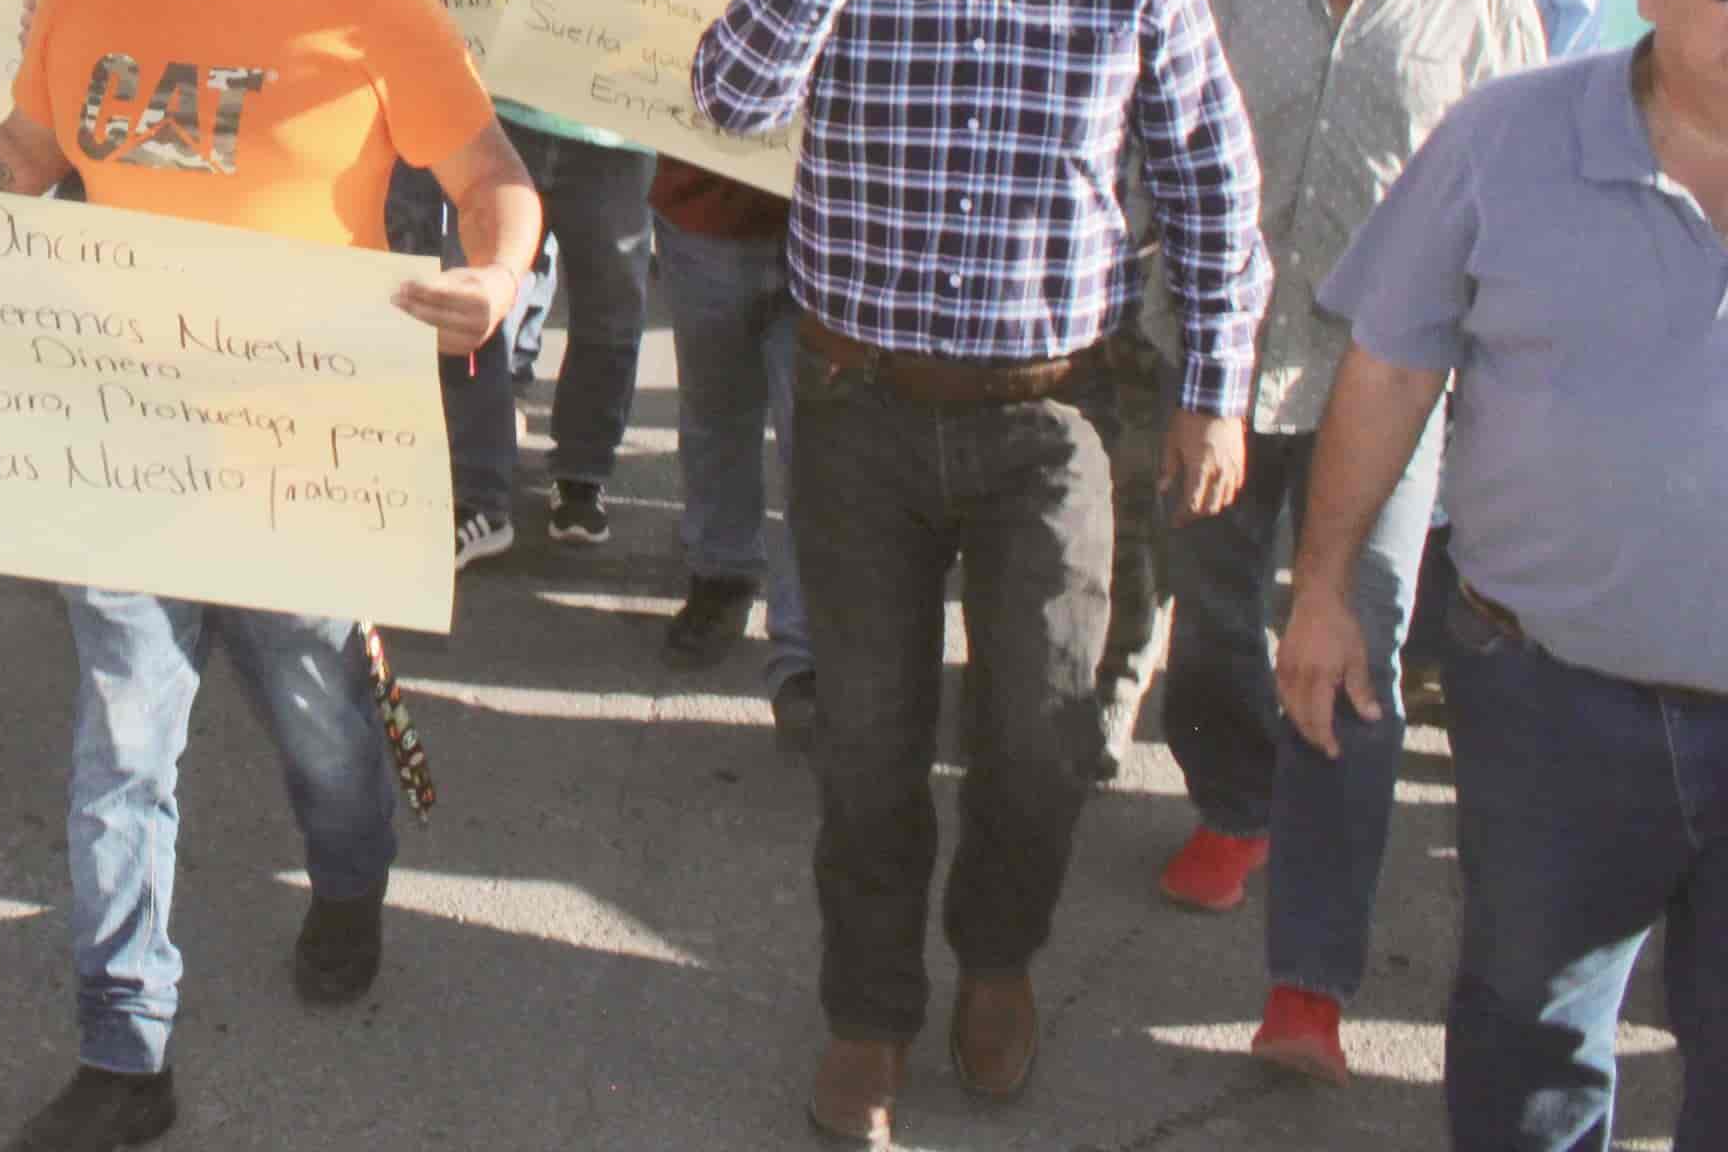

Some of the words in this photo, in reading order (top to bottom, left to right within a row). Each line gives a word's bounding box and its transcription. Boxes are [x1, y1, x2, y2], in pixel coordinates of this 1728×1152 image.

[77, 51, 265, 176] CAT
[177, 312, 358, 377] Nuestro
[65, 439, 245, 497] Nuestro
[329, 424, 418, 470] pero
